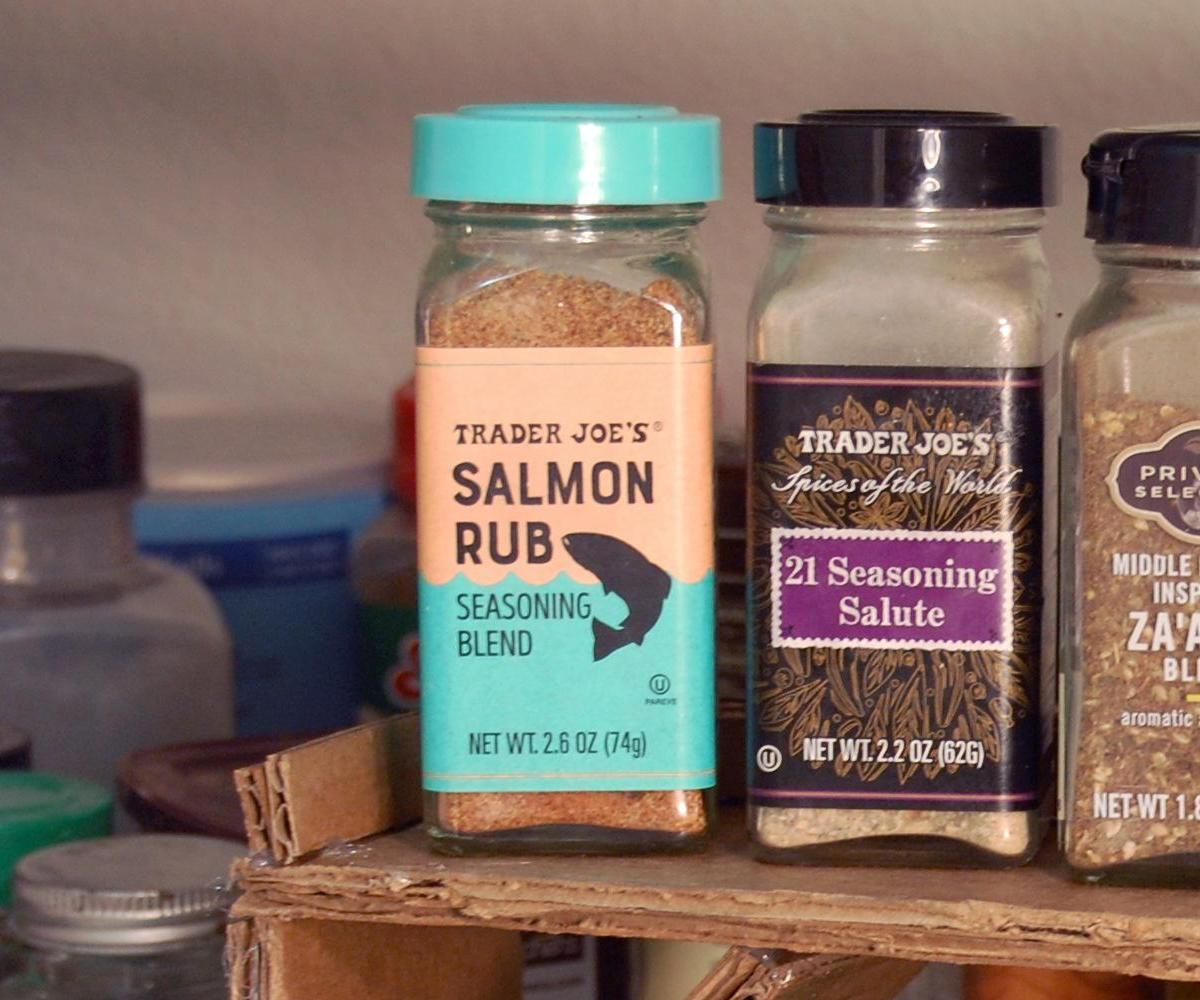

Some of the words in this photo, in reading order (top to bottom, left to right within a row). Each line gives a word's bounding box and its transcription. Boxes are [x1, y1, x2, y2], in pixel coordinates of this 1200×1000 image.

[454, 424, 561, 444] TRADER
[799, 430, 910, 455] TRADER
[912, 431, 992, 456] JOE'S
[453, 461, 653, 505] SALMON
[771, 465, 856, 504] Spices
[861, 467, 892, 505] of
[889, 467, 933, 495] the
[944, 468, 1022, 496] World
[456, 521, 553, 565] RUB
[785, 557, 818, 586] 21
[828, 557, 998, 594] Seasoning
[1113, 554, 1191, 576] MIDDLE
[457, 593, 591, 621] SEASONING
[840, 596, 945, 627] Salute
[458, 630, 532, 657] BLEND
[1120, 710, 1193, 727] aromatic
[469, 732, 500, 755] NET
[506, 732, 538, 755] WT.
[544, 733, 569, 754] 2.6
[575, 733, 597, 754] OZ
[604, 731, 647, 758] (74g)
[803, 737, 836, 762] NET
[841, 737, 874, 763] WT.
[876, 739, 904, 763] 2.2
[910, 739, 933, 763] OZ
[938, 740, 984, 768] (62G)
[1093, 792, 1135, 819] NET
[1137, 793, 1169, 820] WT
